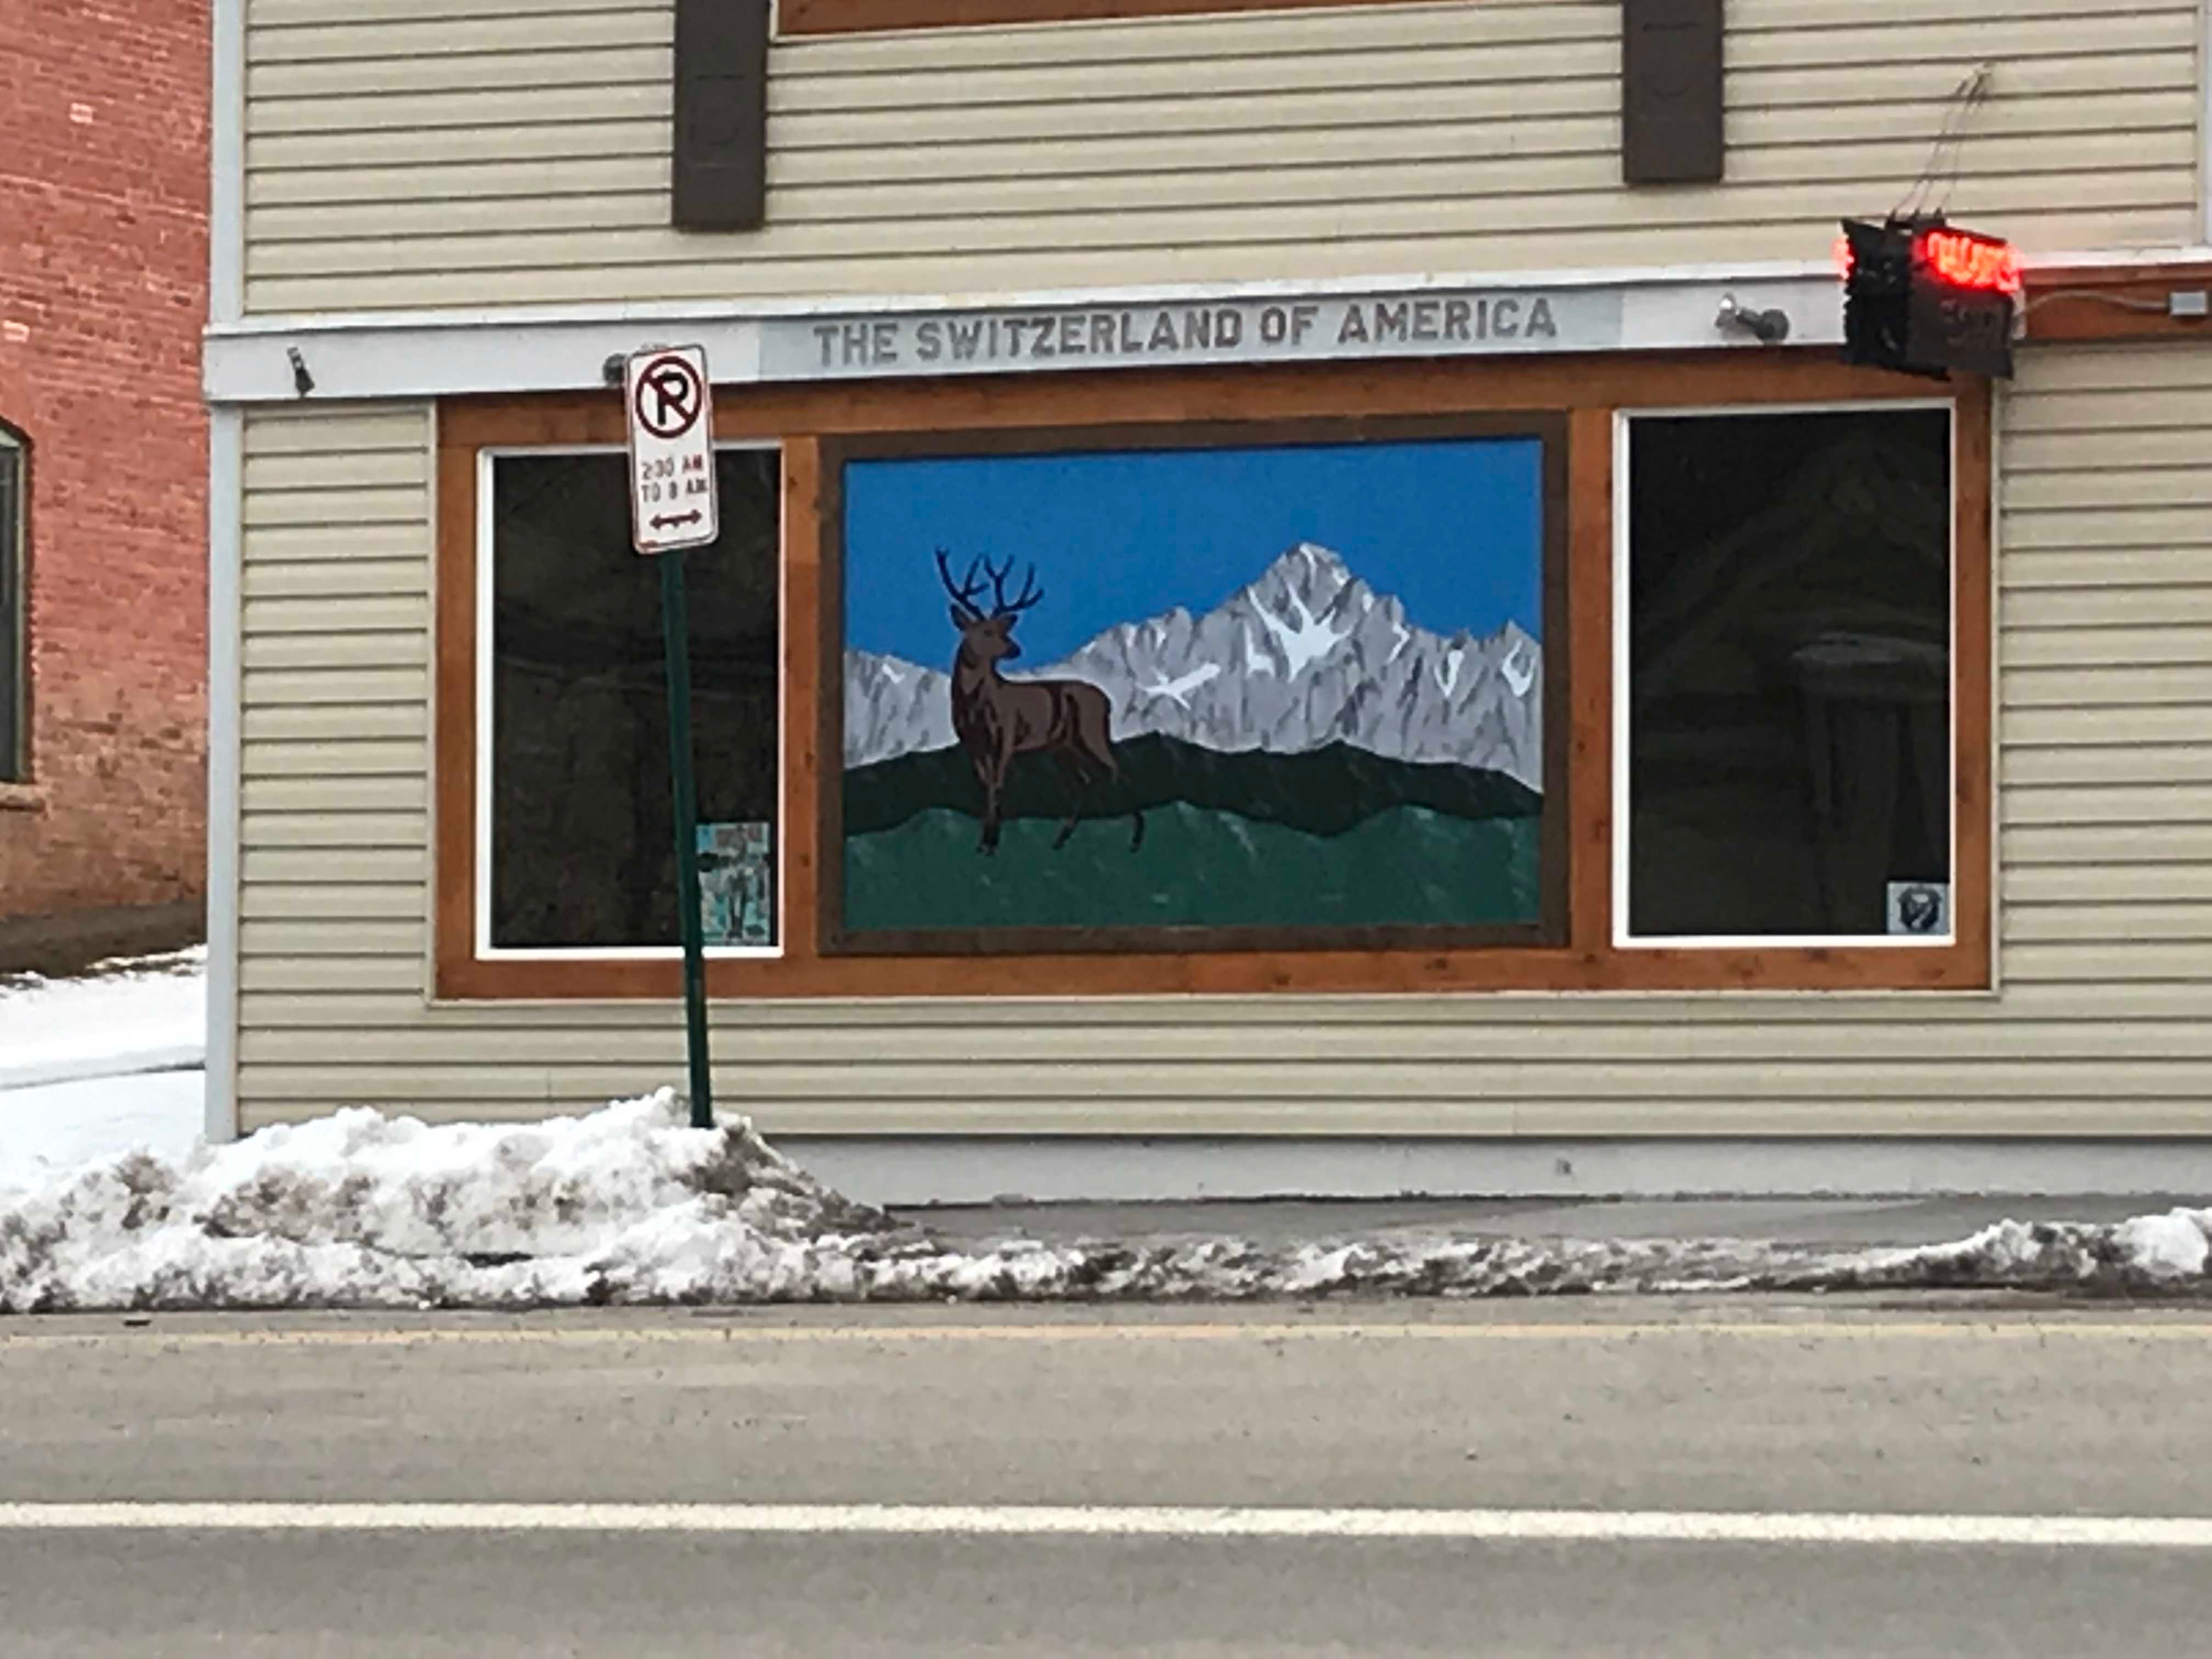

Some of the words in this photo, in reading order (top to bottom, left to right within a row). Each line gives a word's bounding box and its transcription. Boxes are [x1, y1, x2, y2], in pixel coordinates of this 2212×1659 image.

[813, 323, 899, 366] THE
[916, 307, 1242, 362] SWITZERLAND
[1260, 305, 1319, 346] OF
[1337, 297, 1558, 344] AMERICA
[641, 481, 661, 502] TO
